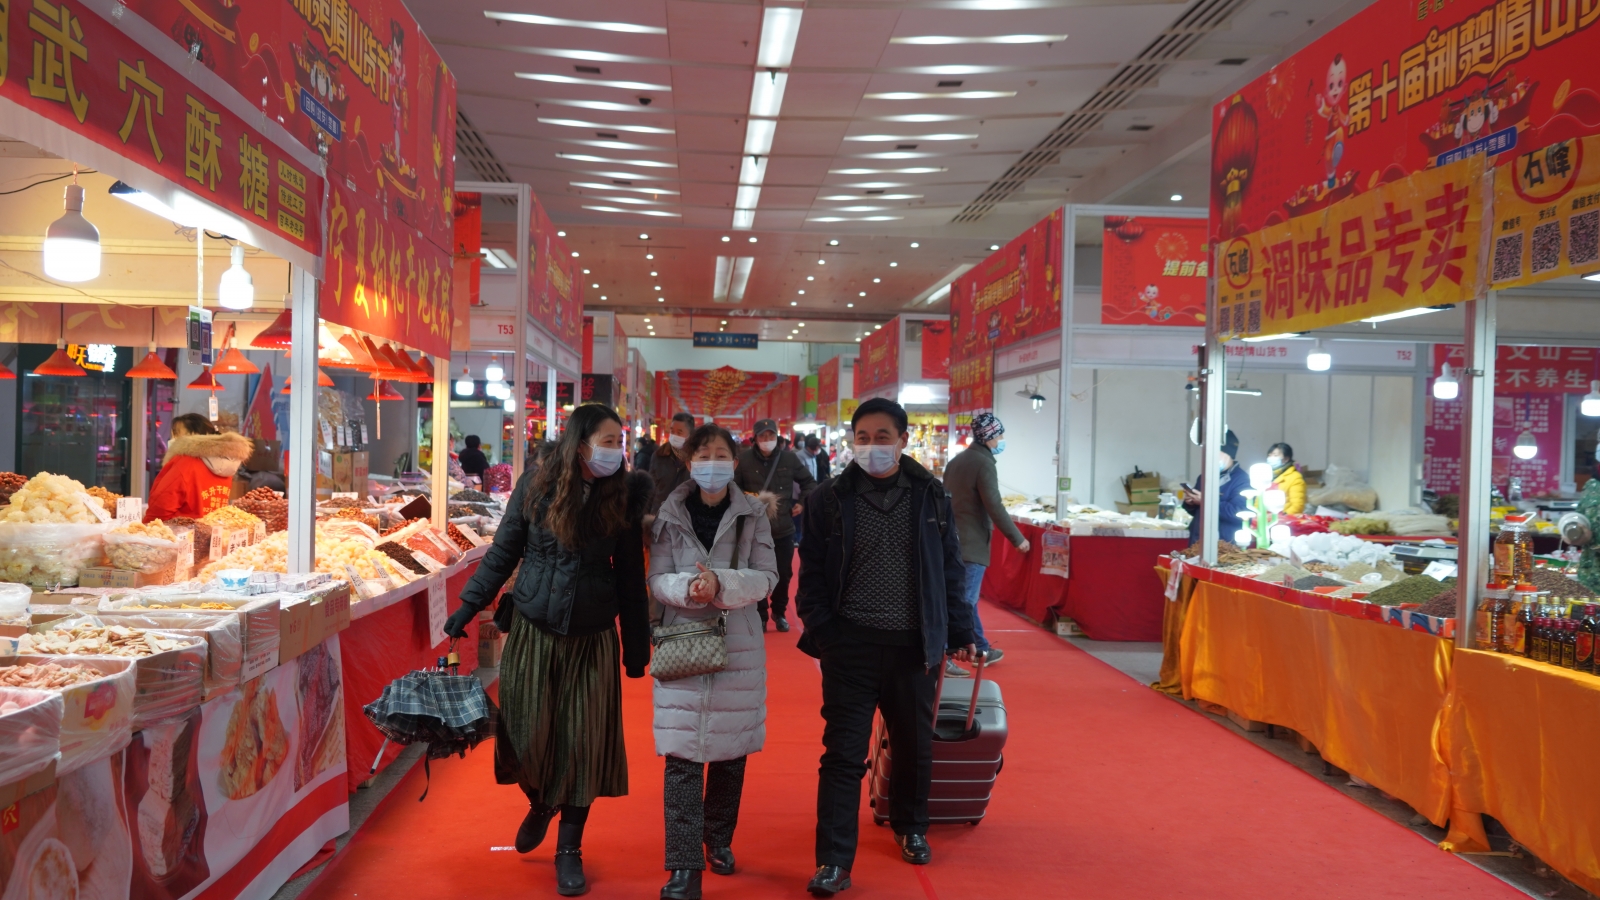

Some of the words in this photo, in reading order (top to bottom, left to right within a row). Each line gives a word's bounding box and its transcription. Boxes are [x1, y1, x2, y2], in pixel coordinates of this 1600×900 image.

[0, 0, 270, 221] 武穴酥糖
[1261, 182, 1470, 321] 调味品专卖
[498, 324, 514, 335] T53
[1191, 345, 1288, 357] 第荆楚情山货节
[1396, 349, 1412, 360] T52
